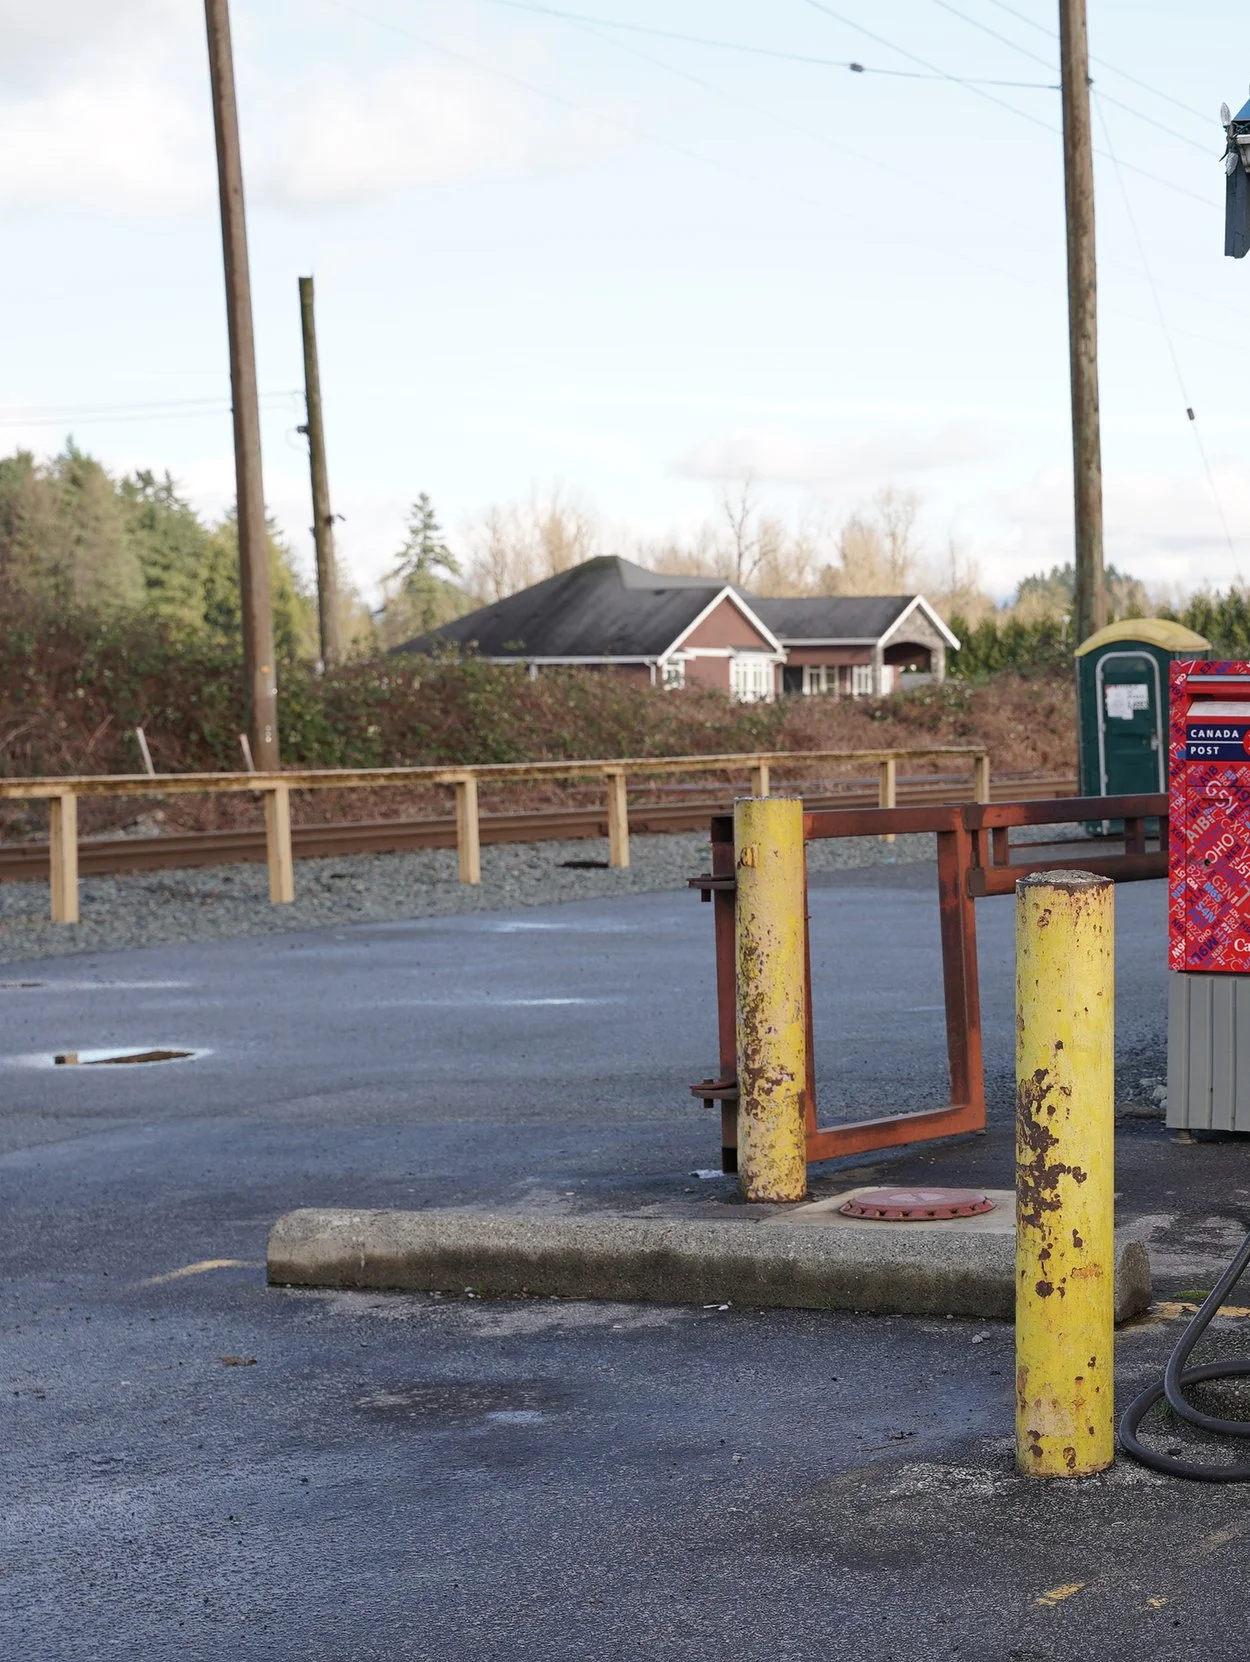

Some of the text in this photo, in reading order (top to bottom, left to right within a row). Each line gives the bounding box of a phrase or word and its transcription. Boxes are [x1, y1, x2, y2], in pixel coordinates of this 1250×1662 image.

[1190, 730, 1239, 738] CANADA
[1190, 746, 1219, 754] POST
[1185, 816, 1211, 843] A1B
[1212, 875, 1236, 899] G3N
[1196, 901, 1216, 923] S4N
